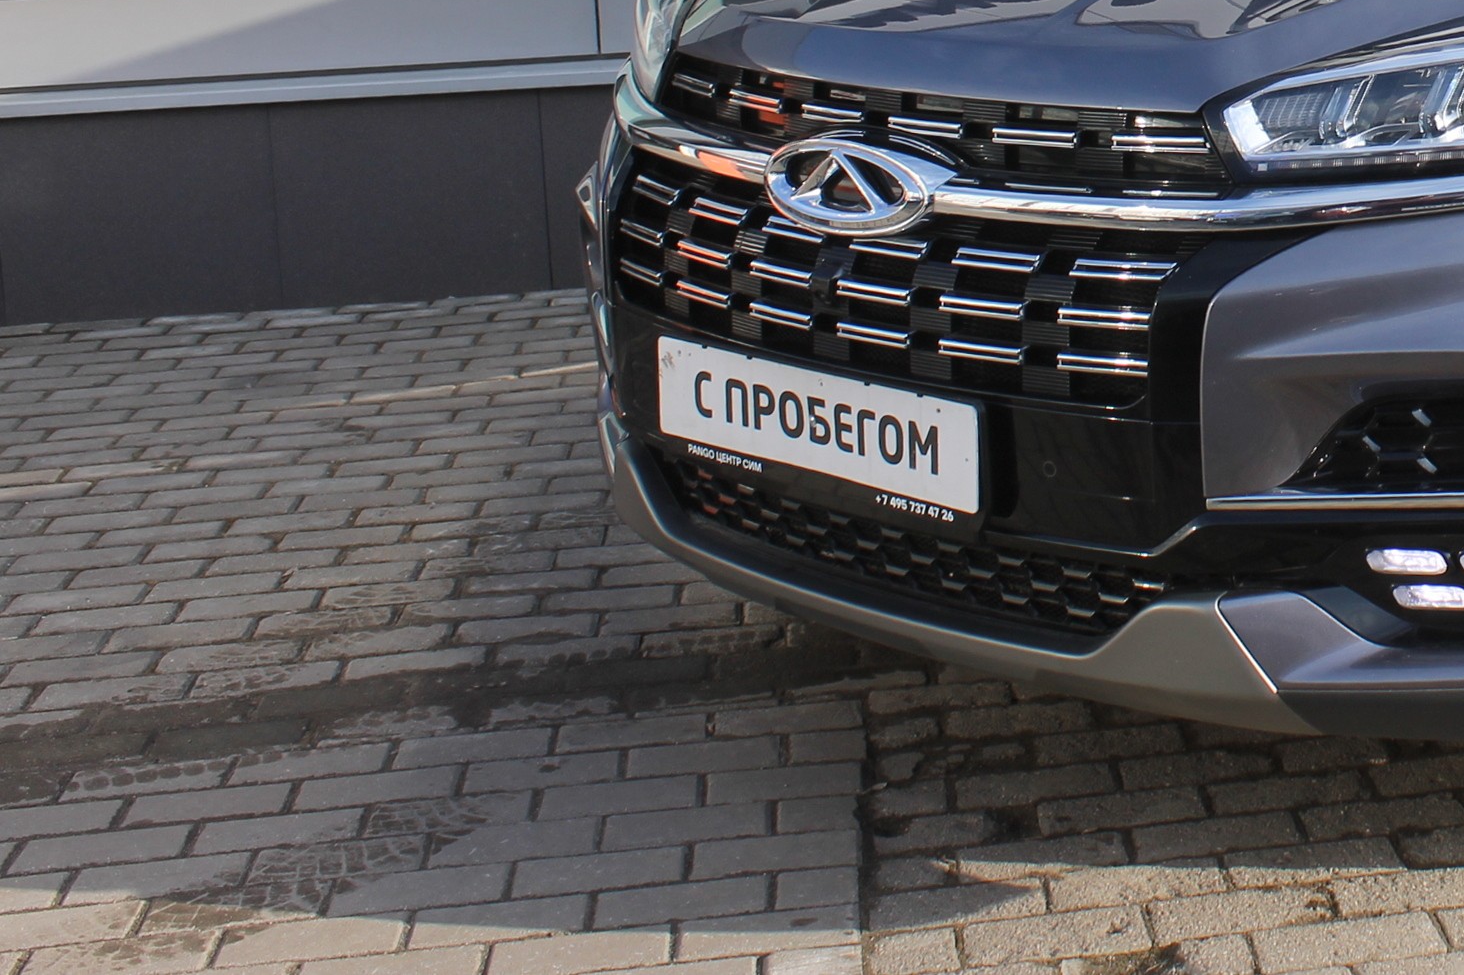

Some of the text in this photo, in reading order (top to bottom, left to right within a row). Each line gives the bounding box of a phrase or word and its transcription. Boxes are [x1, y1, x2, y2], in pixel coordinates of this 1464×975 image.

[694, 371, 939, 475] С ПРОБЕГОМ
[687, 443, 763, 473] PANGO ЦЕНТР СИМ
[875, 493, 954, 522] +7 495 737 47 26
